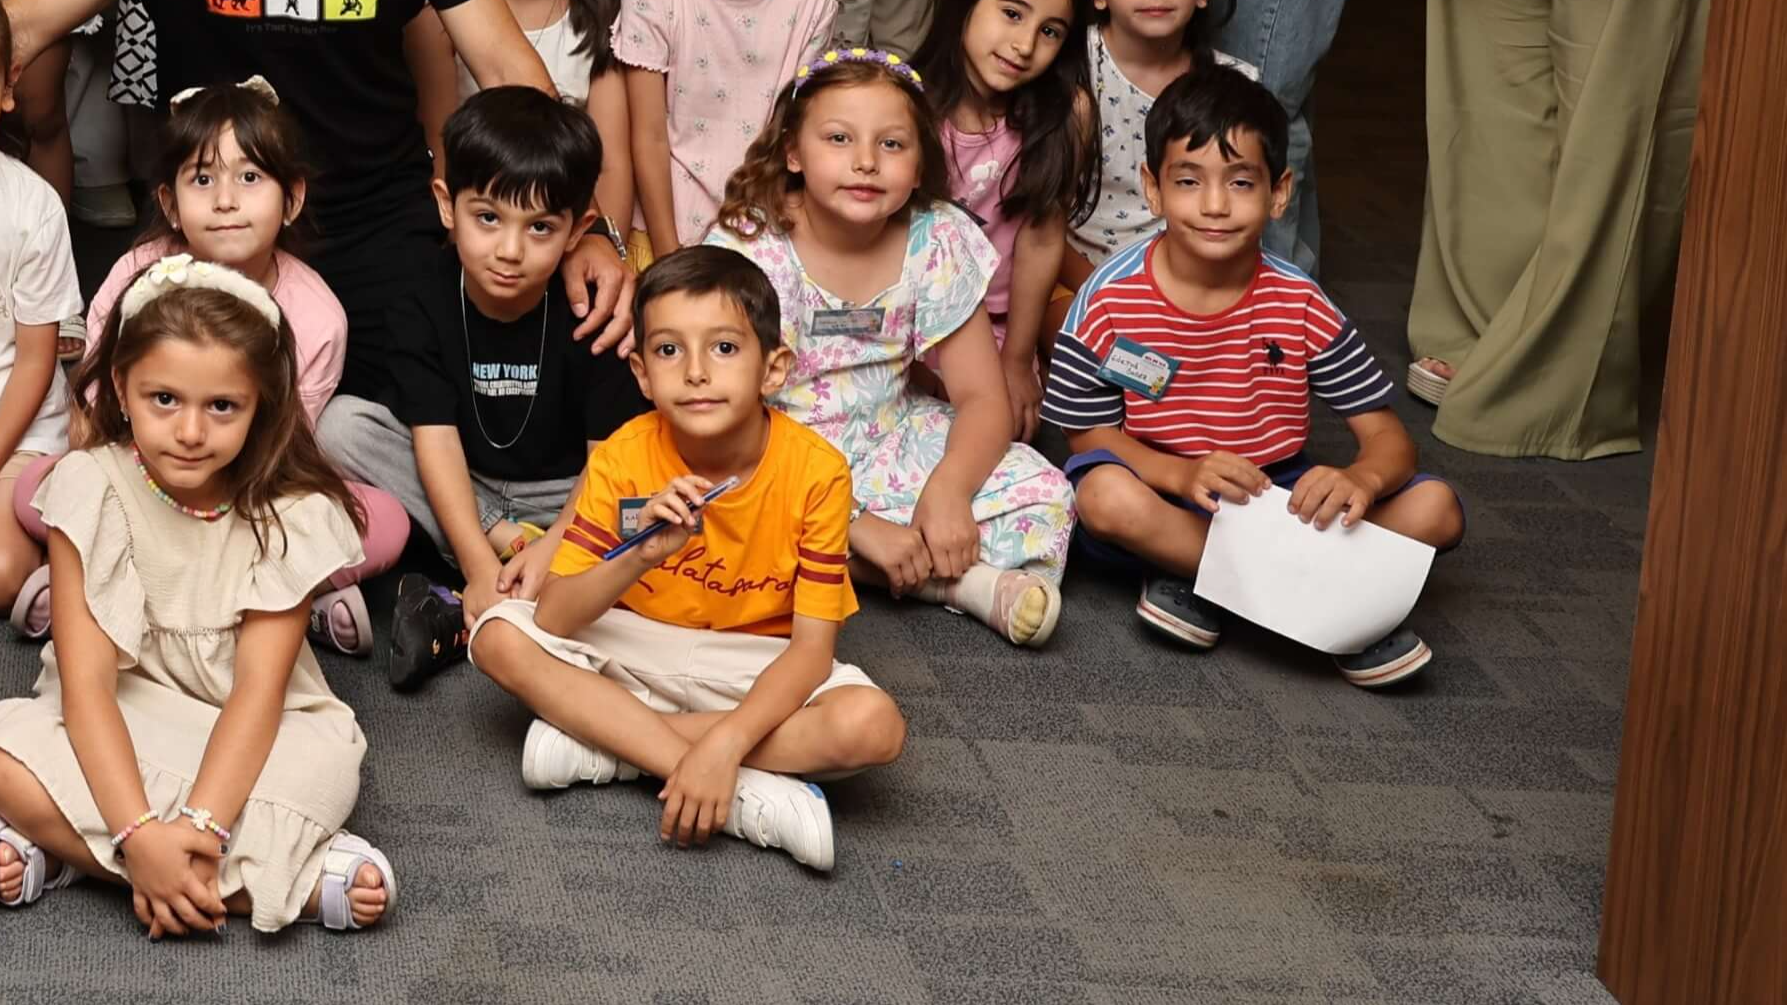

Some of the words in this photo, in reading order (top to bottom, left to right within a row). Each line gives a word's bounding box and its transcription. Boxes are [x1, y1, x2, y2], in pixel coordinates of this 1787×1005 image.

[472, 361, 501, 380] NEW
[502, 363, 539, 380] YORK
[639, 546, 795, 597] alatasara
